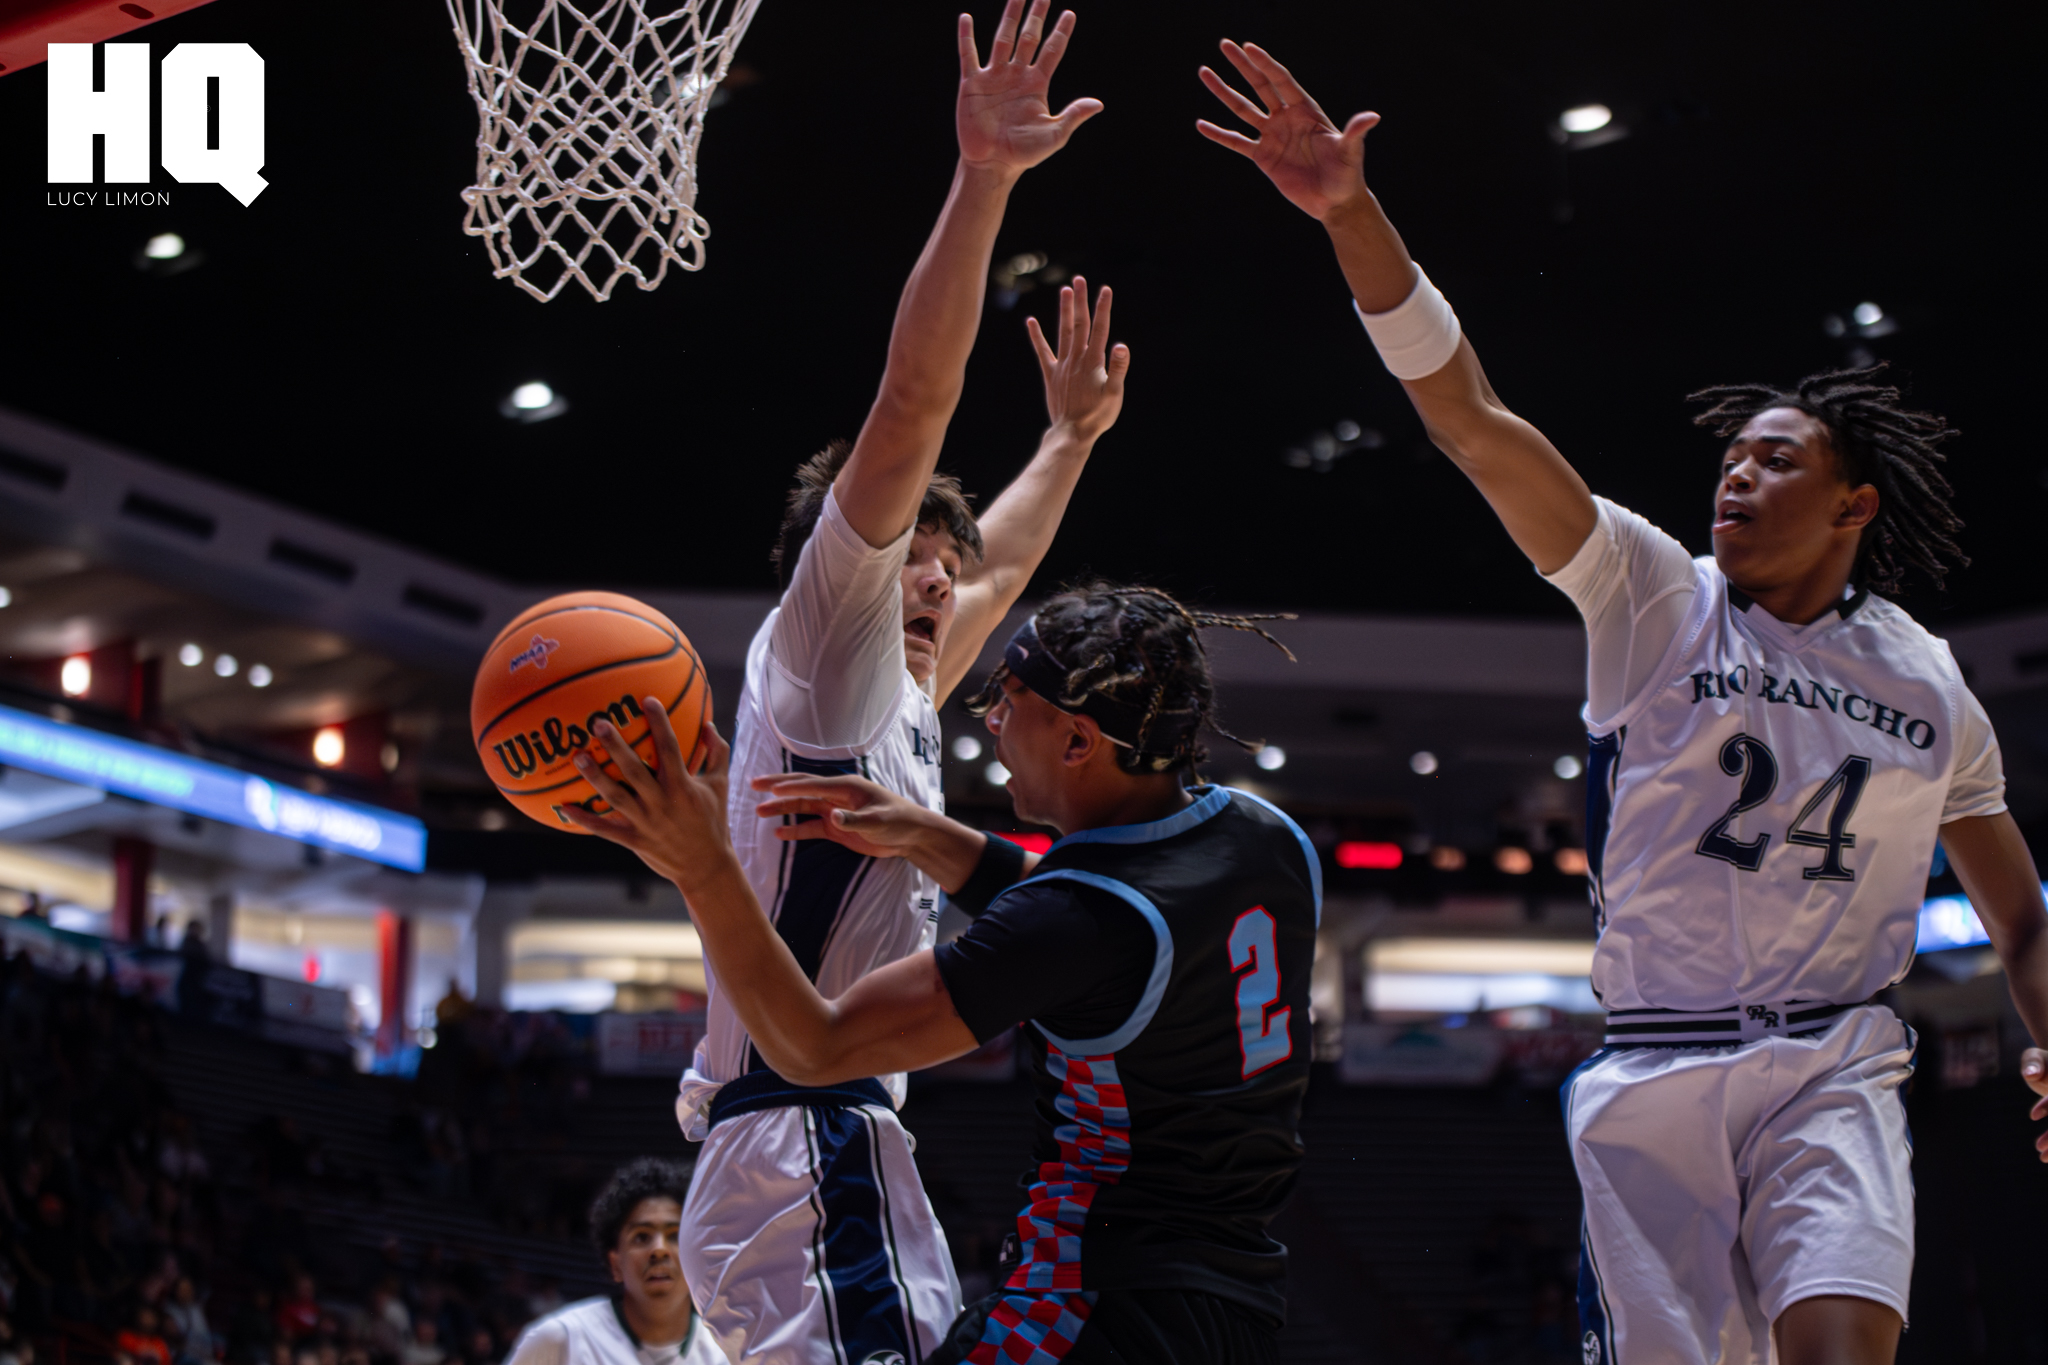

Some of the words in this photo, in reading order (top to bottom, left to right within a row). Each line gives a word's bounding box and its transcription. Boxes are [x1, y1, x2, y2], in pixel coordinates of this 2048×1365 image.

[1690, 664, 1749, 704] RIO
[1757, 667, 1936, 750] RANCHO
[1694, 732, 1872, 882] 24
[1226, 904, 1293, 1082] 2
